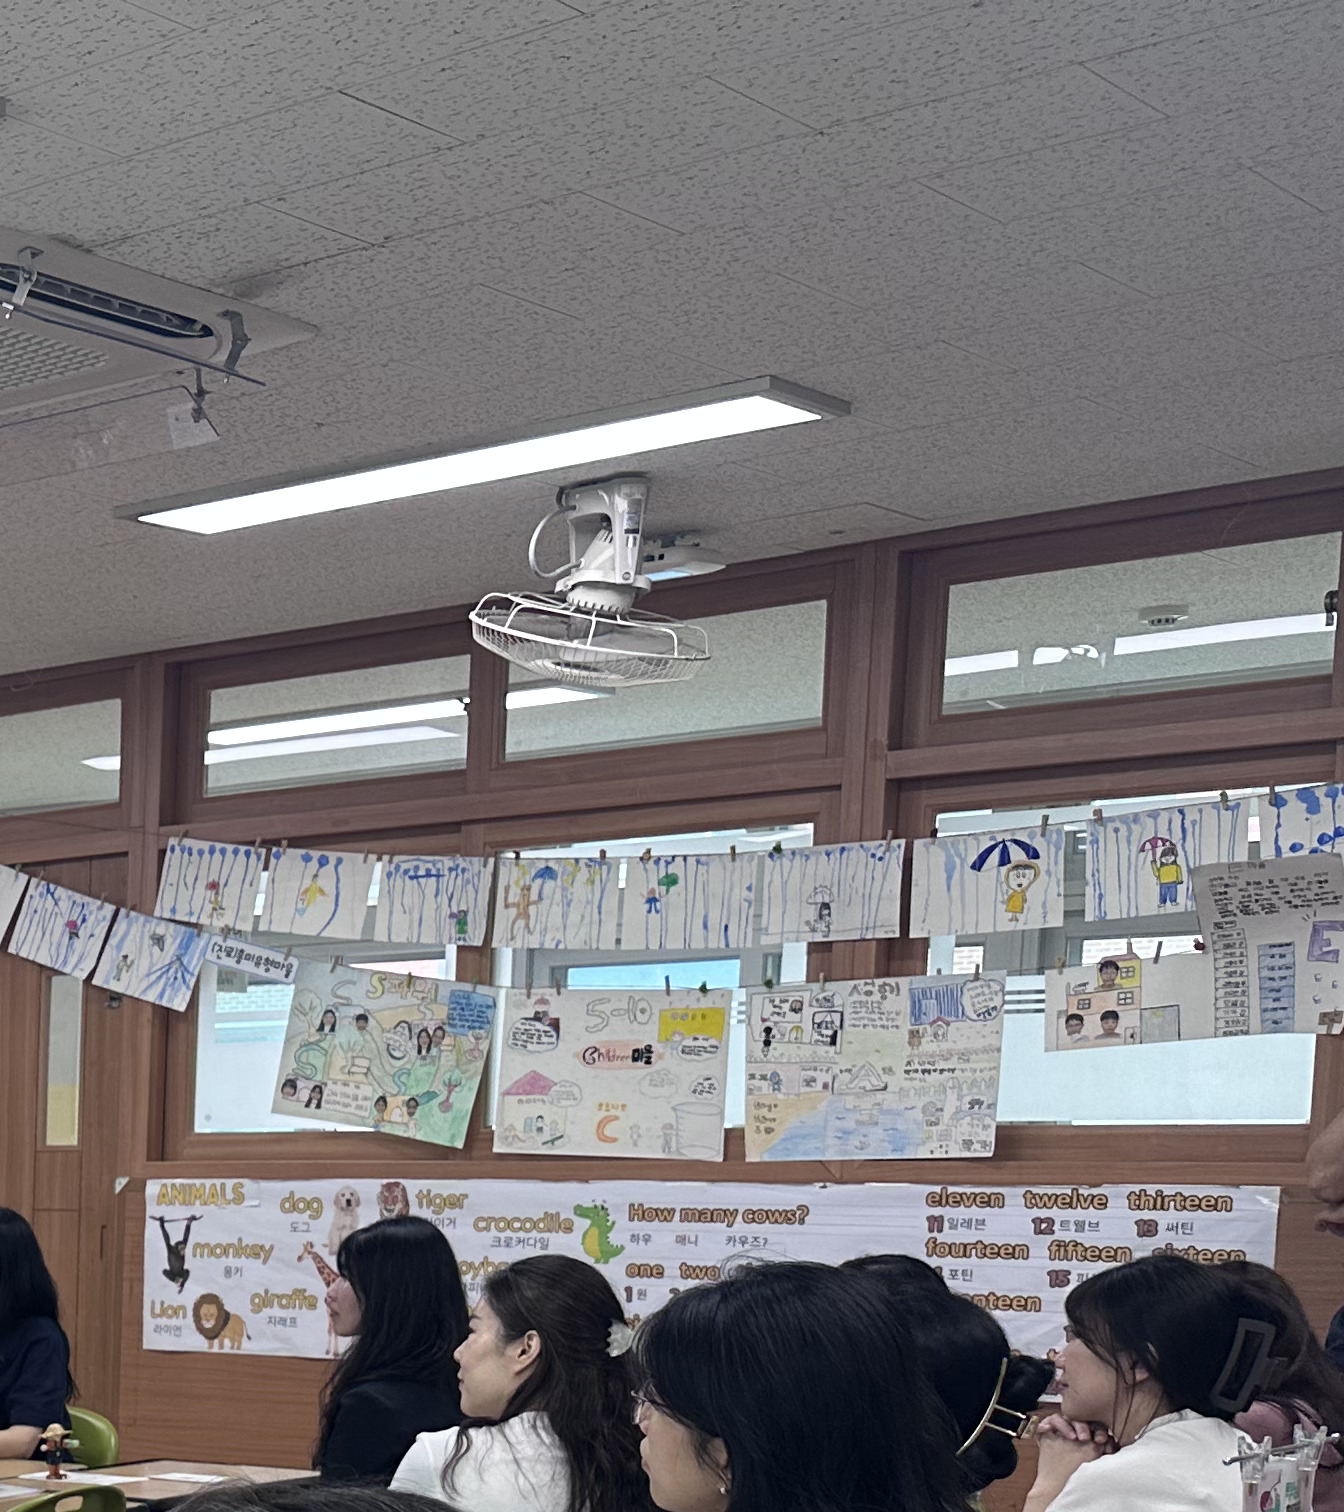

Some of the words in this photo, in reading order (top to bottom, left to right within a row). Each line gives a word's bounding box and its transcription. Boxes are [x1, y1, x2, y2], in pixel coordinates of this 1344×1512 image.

[156, 1182, 246, 1207] ANIMALS
[279, 1190, 324, 1220] dog
[415, 1189, 469, 1215] tiger
[925, 1186, 1005, 1209] eleven
[1023, 1187, 1108, 1210] twelve
[1127, 1189, 1233, 1212] thirteen
[473, 1211, 575, 1234] crocodile
[628, 1203, 675, 1223] How
[679, 1207, 738, 1227] many
[742, 1205, 810, 1225] cows?
[926, 1214, 944, 1234] 11
[947, 1217, 986, 1231] 일레븐
[1031, 1216, 1056, 1235] 12
[1134, 1218, 1158, 1237] 13
[1165, 1221, 1194, 1236] 써틴
[289, 1221, 312, 1233] 도그
[192, 1237, 275, 1265] monkey
[490, 1236, 550, 1251] 크로커다일
[629, 1233, 652, 1246] 하우
[675, 1234, 699, 1247] 매니
[725, 1234, 768, 1248] 카우즈?
[925, 1236, 1030, 1260] fourteen
[1048, 1239, 1133, 1263] fifteen
[625, 1262, 665, 1279] one
[679, 1261, 722, 1280] two
[1047, 1269, 1072, 1289] 15
[250, 1288, 319, 1315] giraffe
[624, 1286, 633, 1303] 1
[150, 1299, 188, 1320] Lion
[154, 1324, 183, 1337] 라이언
